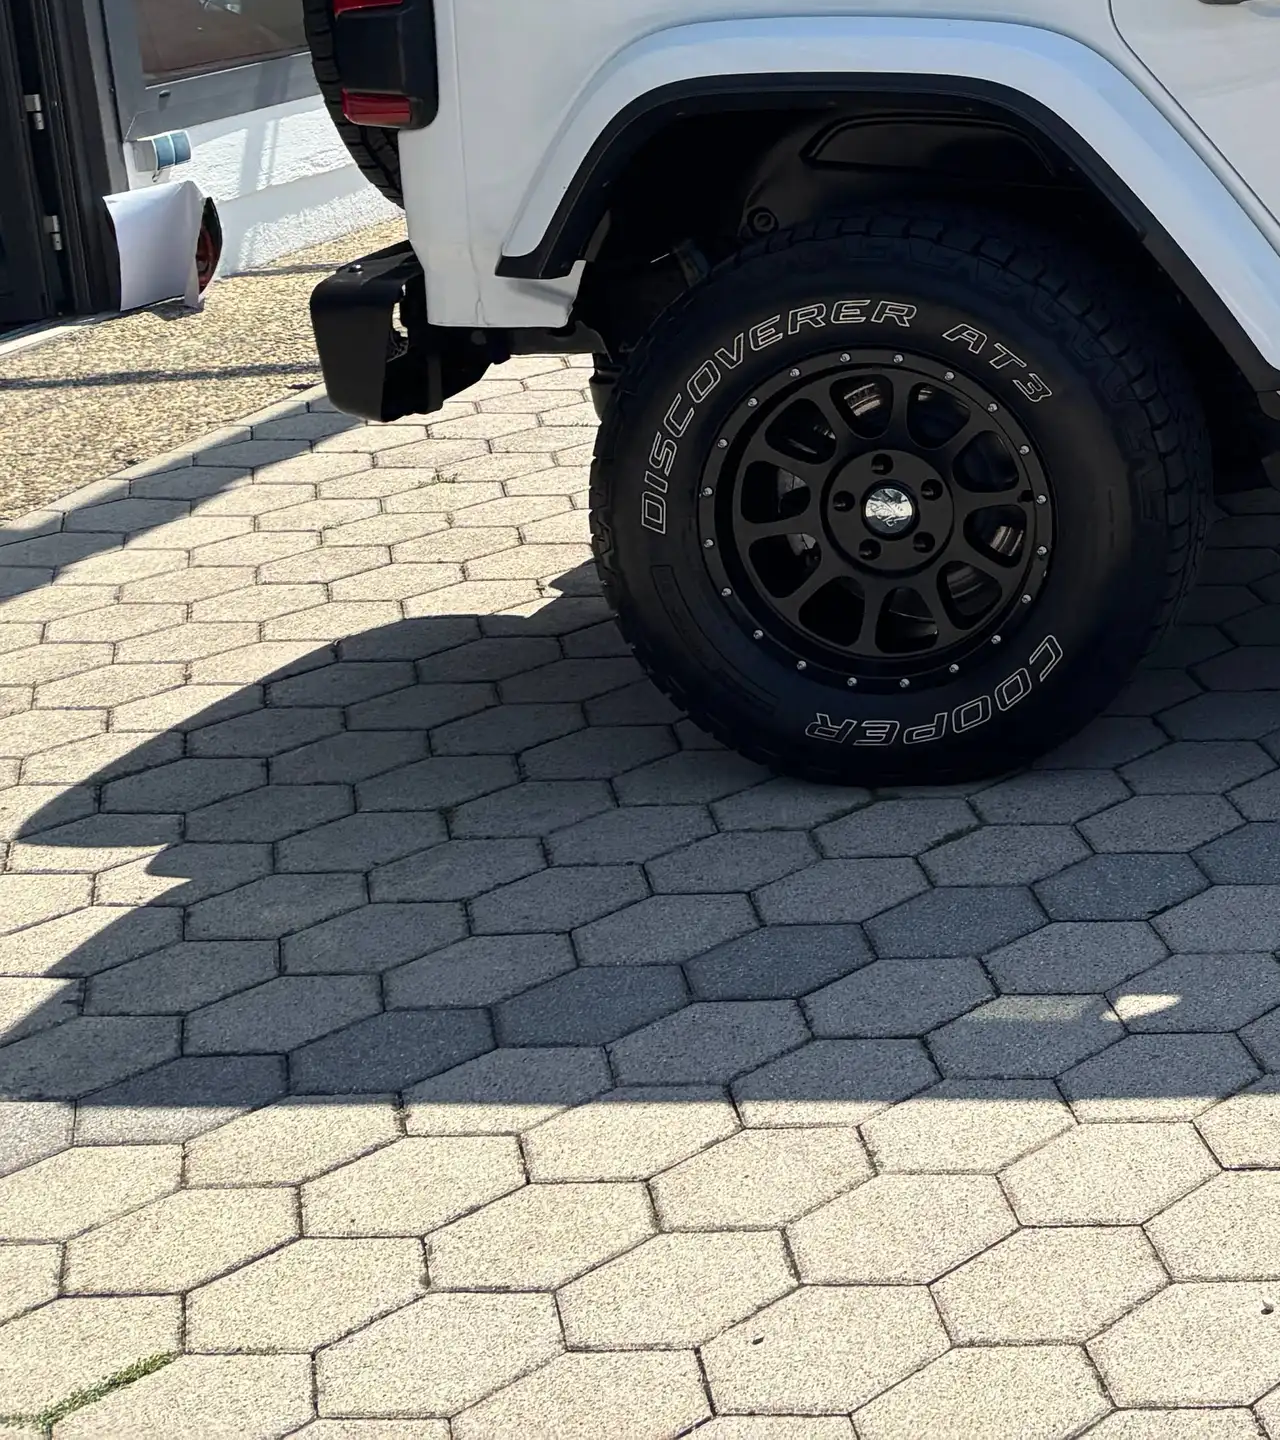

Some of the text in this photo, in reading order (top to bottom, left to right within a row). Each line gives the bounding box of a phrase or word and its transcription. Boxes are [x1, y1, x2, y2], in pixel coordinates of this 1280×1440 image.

[641, 299, 1053, 535] DISCOVERER AT3
[805, 634, 1064, 746] COOPER
